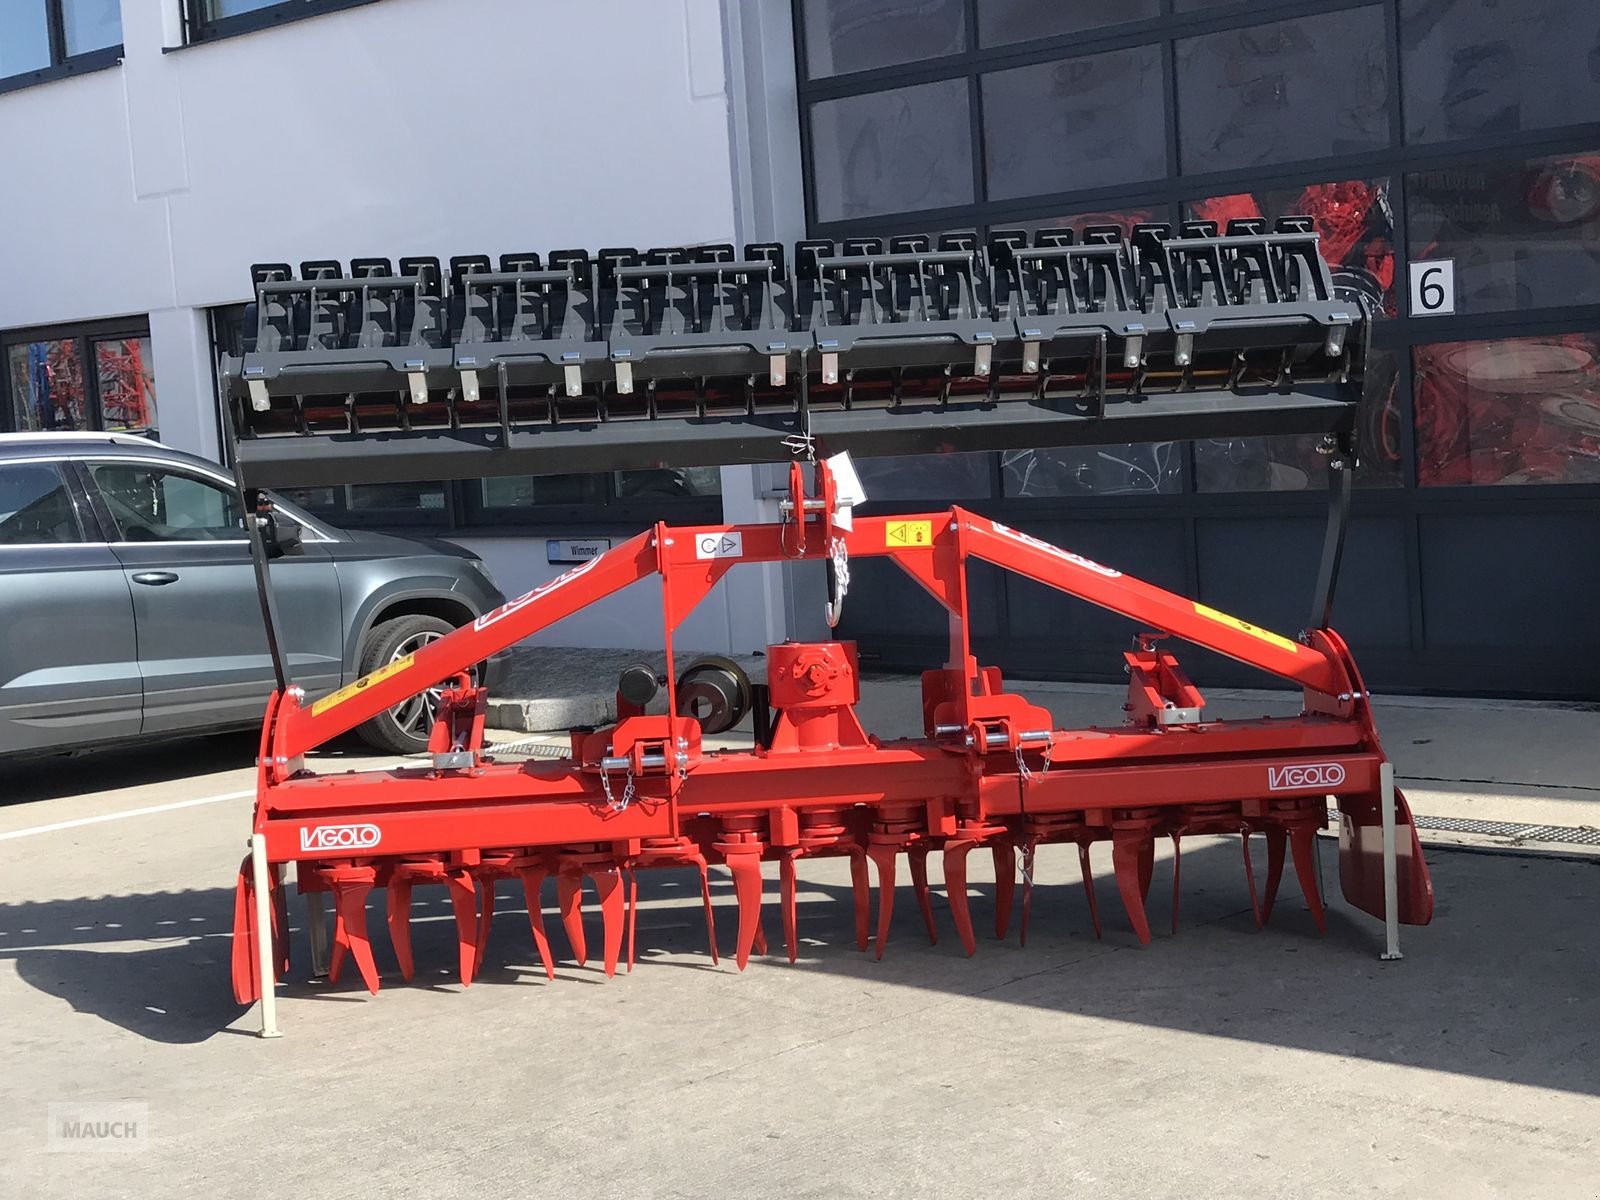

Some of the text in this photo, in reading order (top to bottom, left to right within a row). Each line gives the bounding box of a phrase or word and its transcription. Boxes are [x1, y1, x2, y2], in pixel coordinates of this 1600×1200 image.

[1420, 267, 1445, 310] 6
[571, 545, 598, 556] Wimmer
[1268, 763, 1345, 790] VIGOLO
[300, 824, 381, 851] VIGOLO
